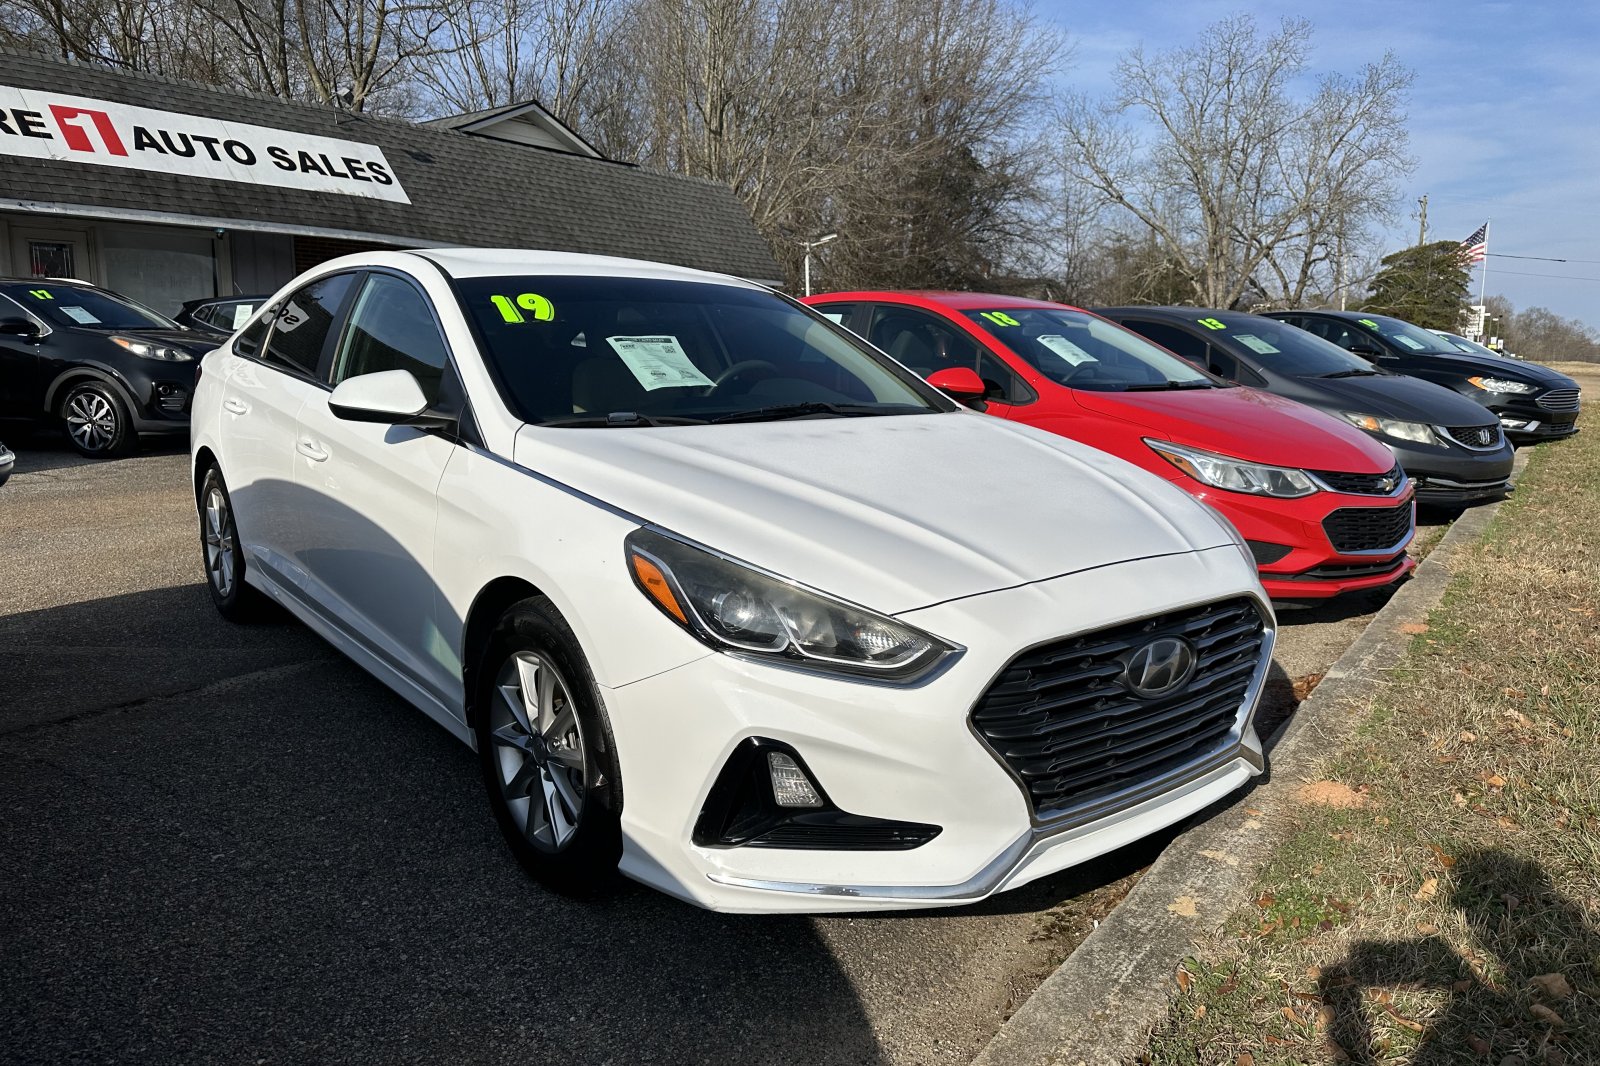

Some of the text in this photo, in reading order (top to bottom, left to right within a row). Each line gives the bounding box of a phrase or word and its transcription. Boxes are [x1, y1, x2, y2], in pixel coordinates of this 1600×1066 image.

[60, 111, 115, 155] 1
[133, 125, 257, 165] AUTO
[266, 146, 393, 185] SALES
[29, 290, 54, 299] 17
[491, 293, 554, 323] 19
[980, 312, 1020, 326] 18
[1198, 318, 1226, 330] 13
